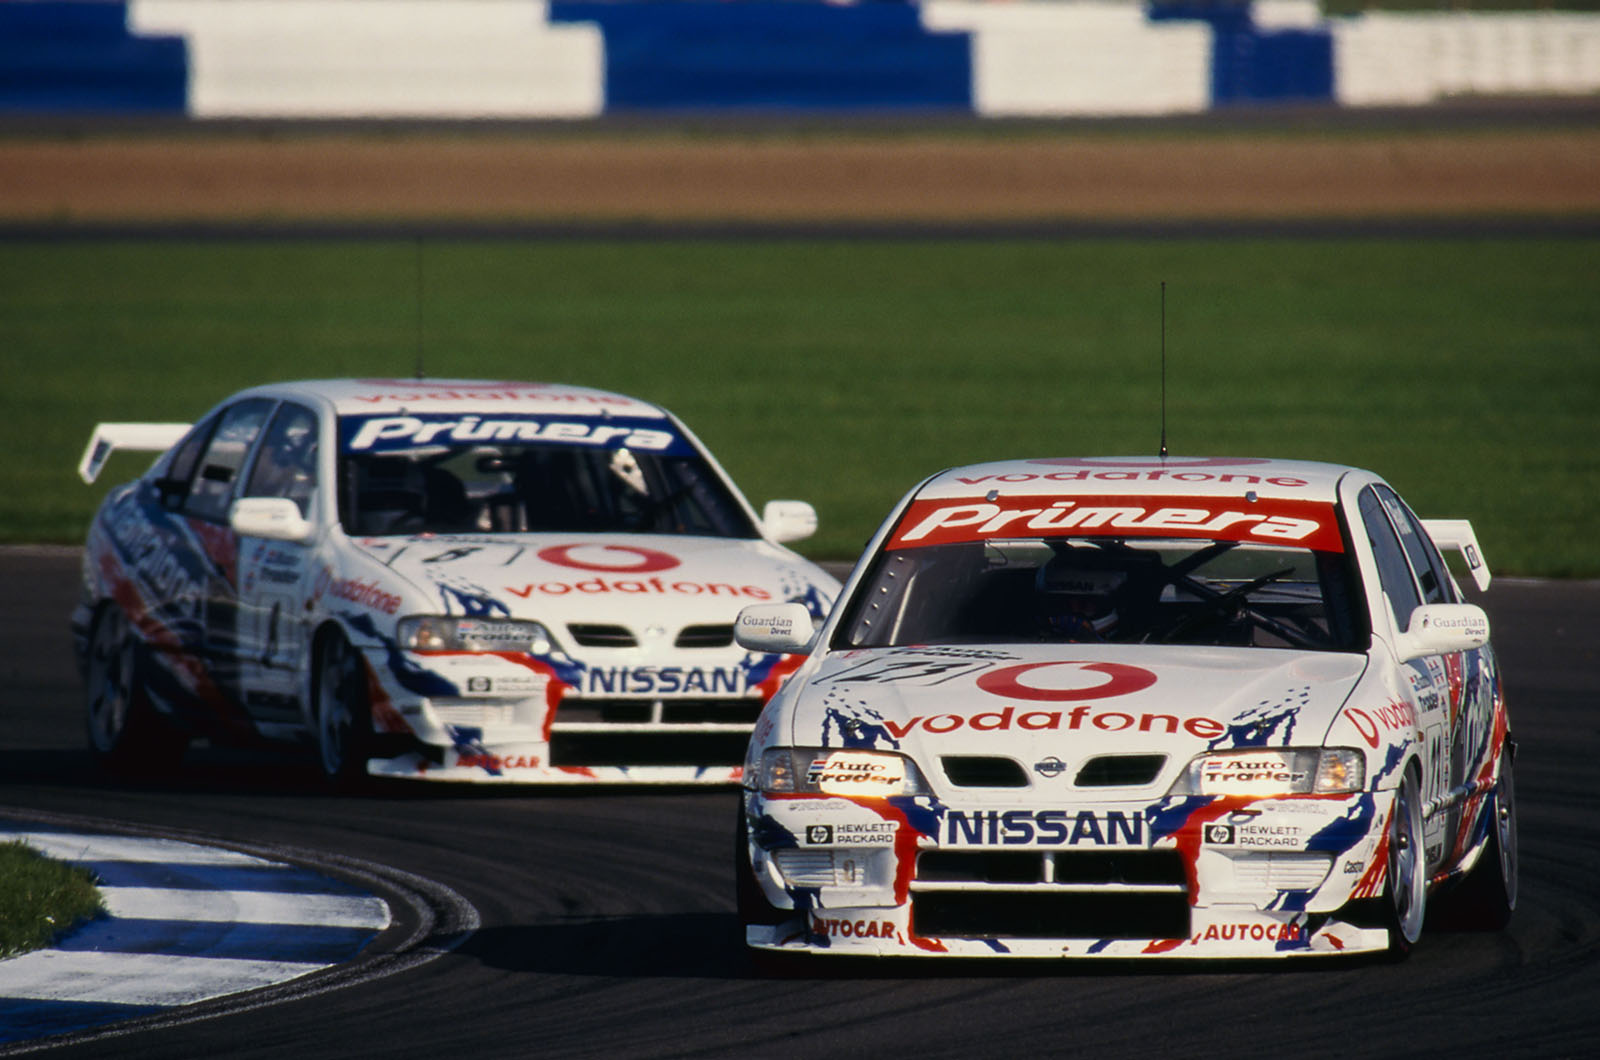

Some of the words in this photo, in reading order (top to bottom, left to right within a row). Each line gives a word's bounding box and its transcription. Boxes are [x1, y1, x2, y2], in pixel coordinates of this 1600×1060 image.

[350, 415, 674, 450] Primera
[955, 469, 1310, 488] vodafone
[901, 501, 1321, 541] Primera
[504, 577, 772, 601] vodafone
[742, 615, 793, 628] Guardian
[1432, 616, 1486, 628] Guardian
[770, 627, 792, 636] Direct
[588, 666, 741, 693] NISSAN
[882, 706, 1226, 740] vodafone
[825, 761, 887, 772] Auto
[1226, 760, 1287, 770] Auto
[807, 772, 902, 784] Trader
[1205, 771, 1305, 783] Trader
[836, 823, 896, 833] HEWLETT
[948, 810, 1143, 846] NISSAN
[1240, 826, 1301, 836] HEWLETT
[836, 834, 894, 844] PACKARD
[1240, 836, 1299, 846] PACKARD
[1203, 924, 1301, 941] AUTOCAR
